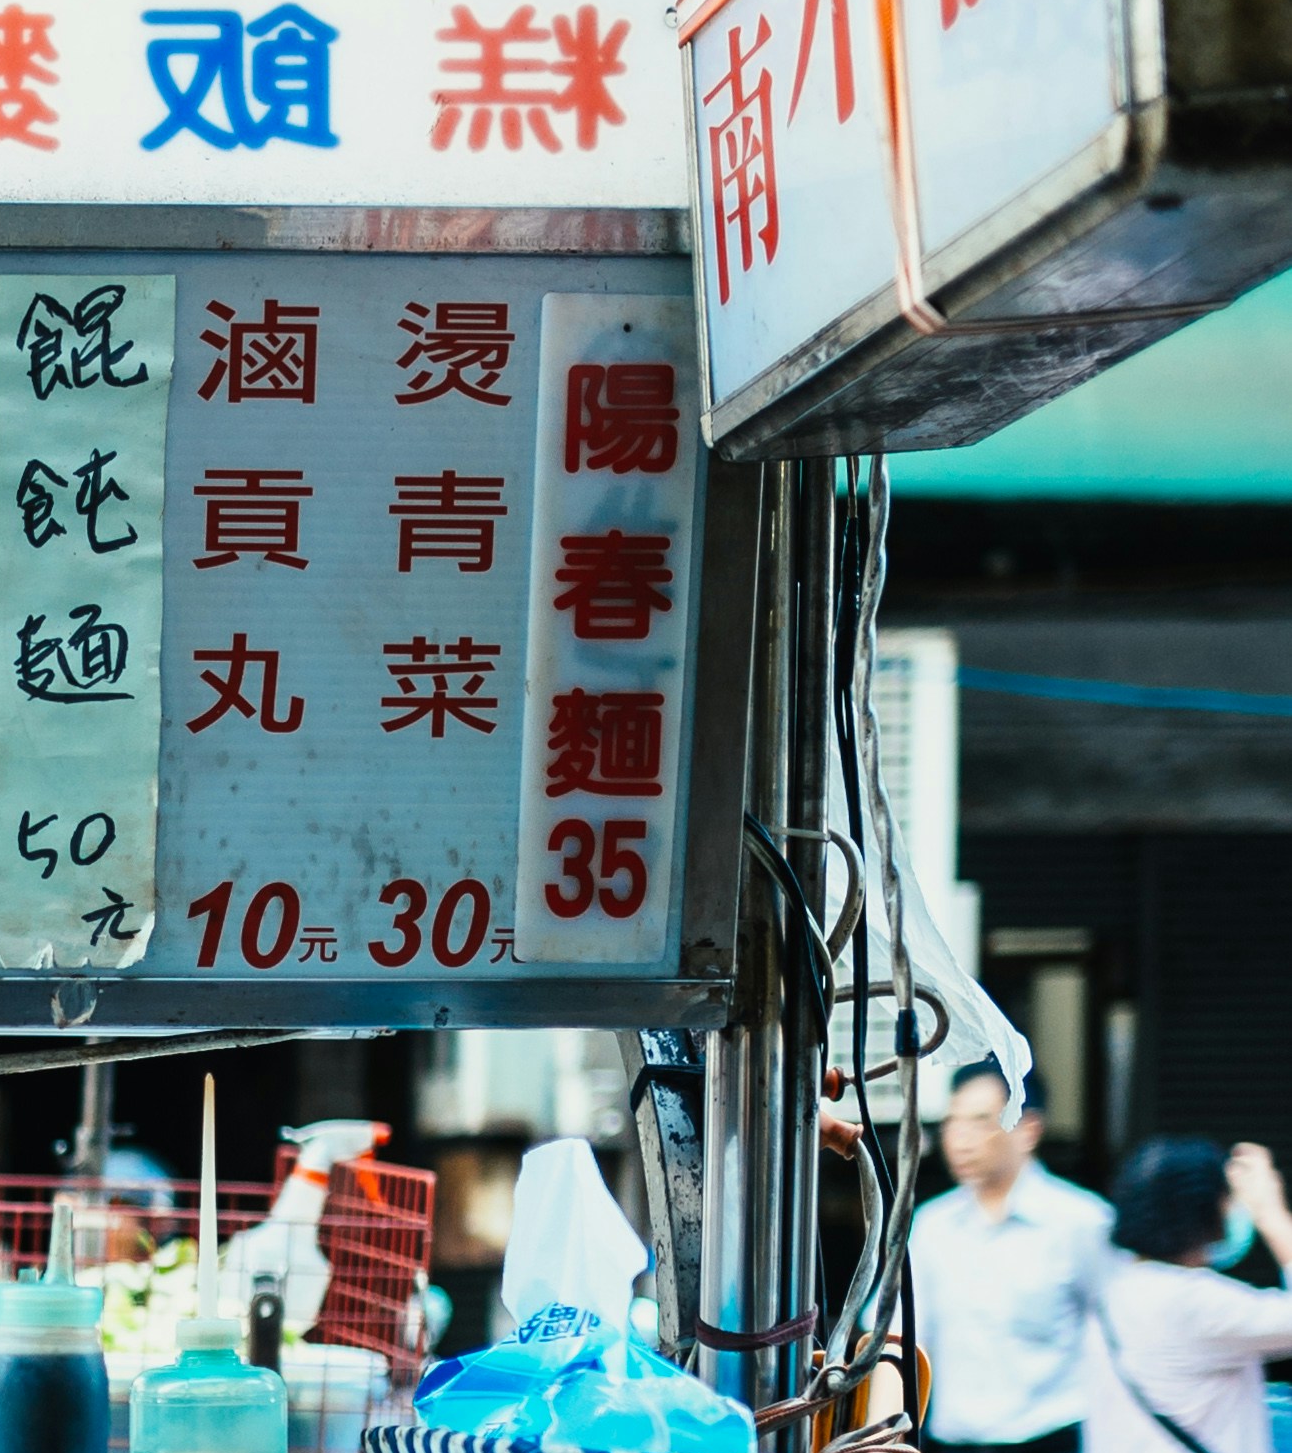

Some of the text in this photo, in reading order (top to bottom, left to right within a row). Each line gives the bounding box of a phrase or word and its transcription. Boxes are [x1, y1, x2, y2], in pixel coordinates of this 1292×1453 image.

[185, 299, 320, 734] 滷貢丸
[380, 301, 516, 738] 燙青菜
